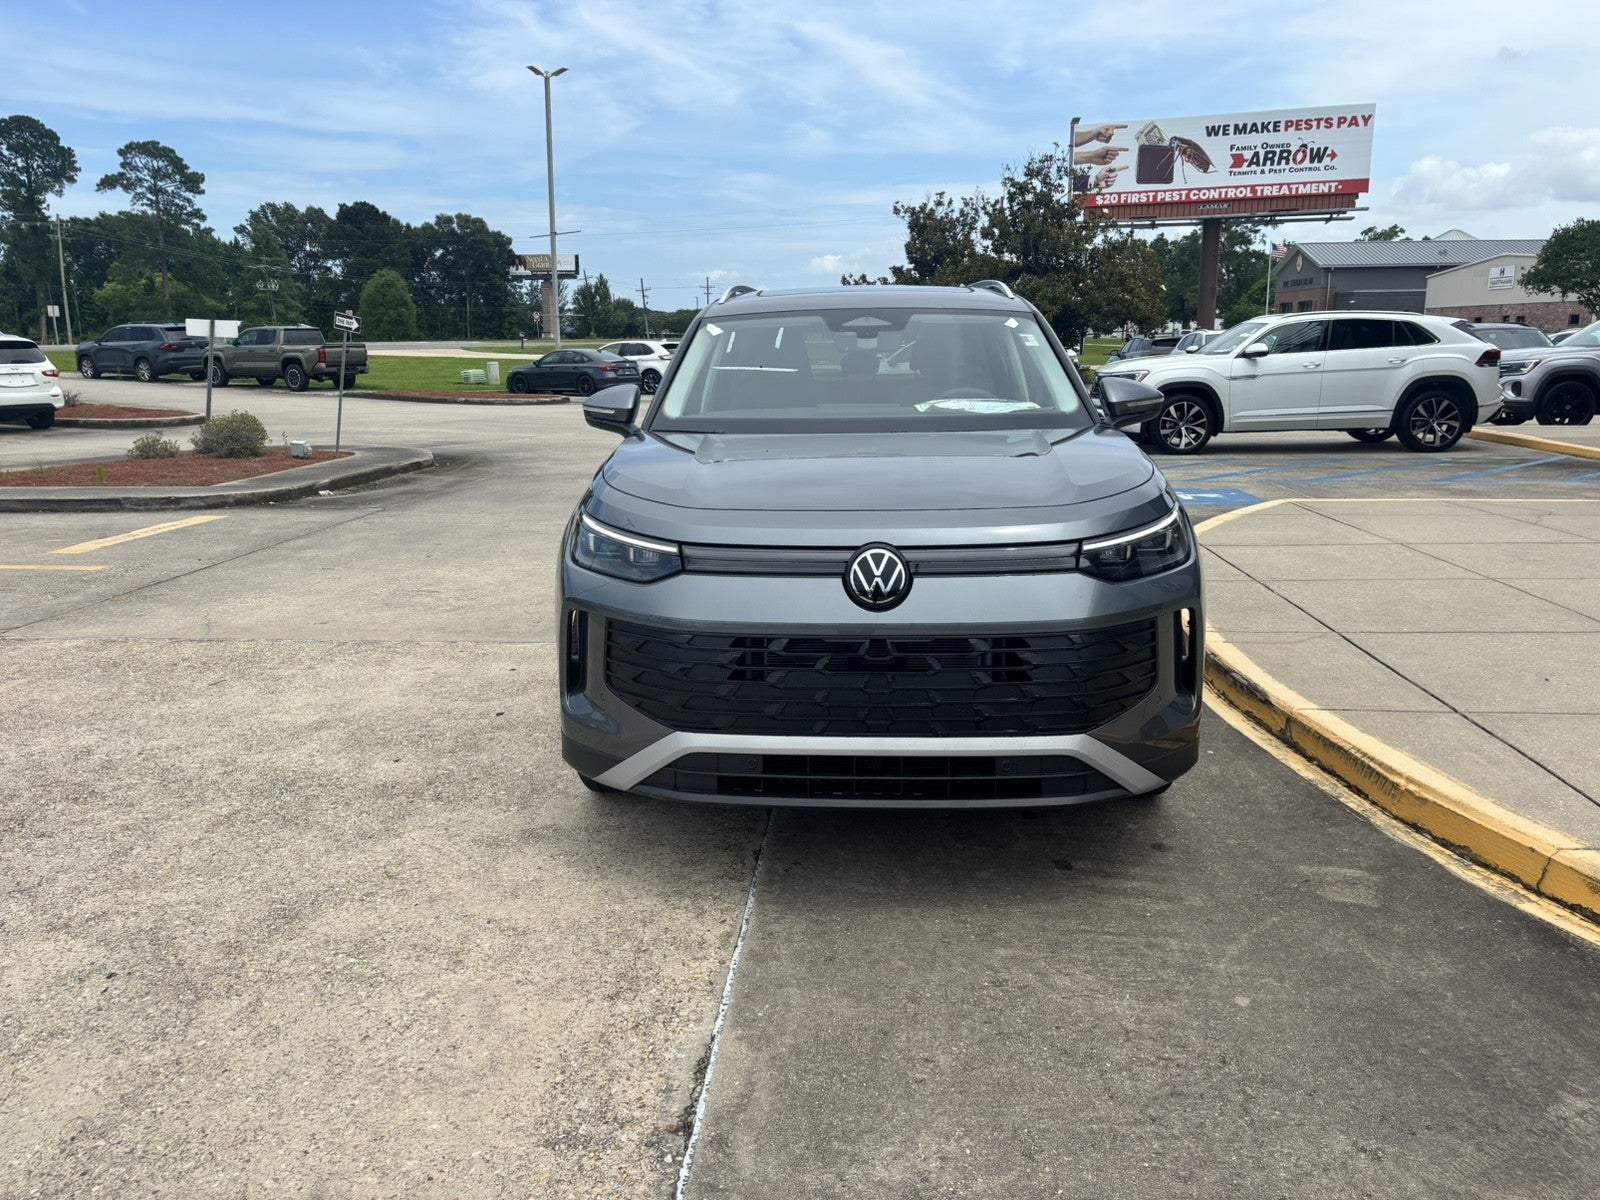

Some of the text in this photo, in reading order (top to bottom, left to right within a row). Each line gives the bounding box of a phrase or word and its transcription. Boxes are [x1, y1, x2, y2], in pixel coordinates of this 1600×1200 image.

[1205, 114, 1373, 137] WE MAKE PESTS PAY
[1229, 141, 1291, 152] FAMILY OWNED
[1247, 147, 1329, 168] ARROW
[1228, 168, 1258, 177] TERMITE
[1269, 167, 1286, 175] PEST
[1288, 165, 1322, 174] CONTROL
[1095, 193, 1119, 206] $20
[1121, 192, 1155, 204] FIRST
[1157, 190, 1188, 203] PEST
[1190, 187, 1253, 201] CONTROL
